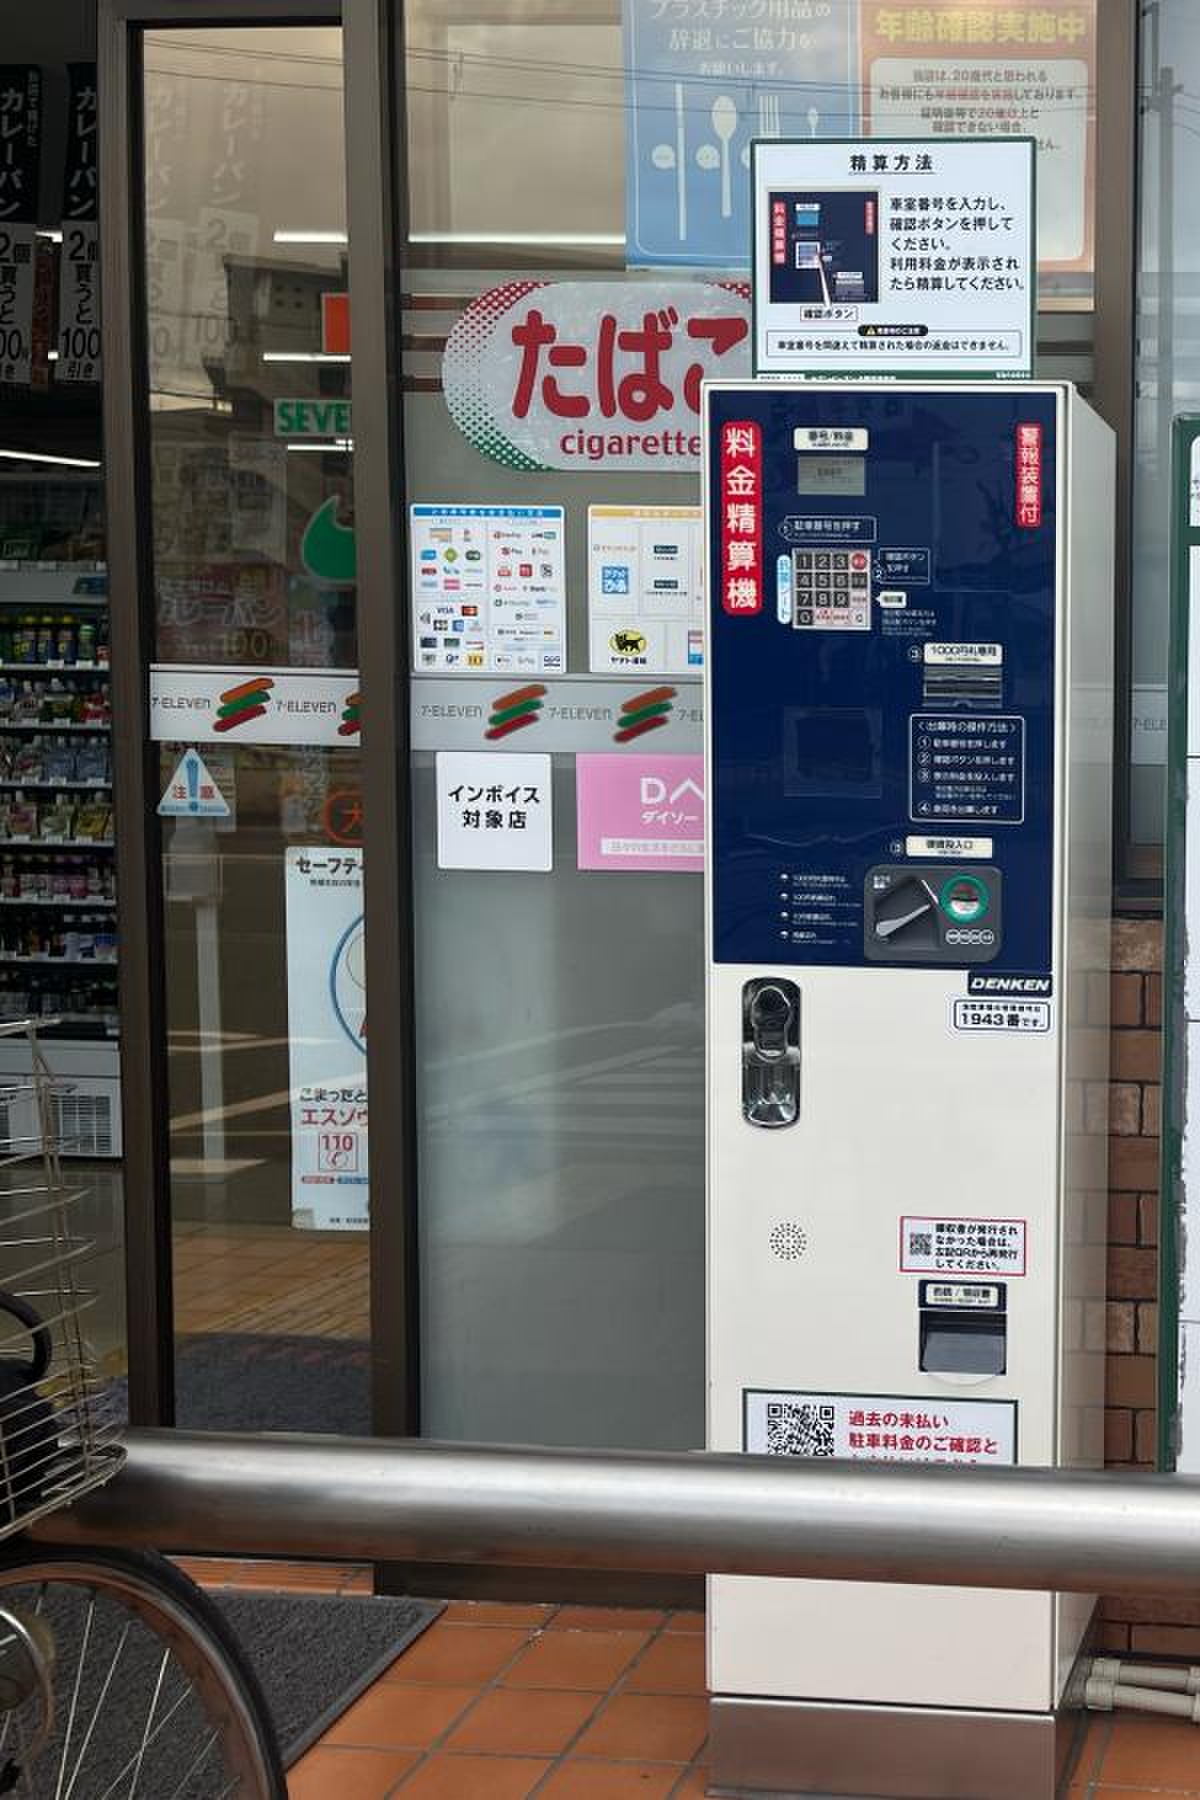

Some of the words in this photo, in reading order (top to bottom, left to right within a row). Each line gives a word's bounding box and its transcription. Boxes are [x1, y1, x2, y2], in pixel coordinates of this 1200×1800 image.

[849, 153, 935, 172] 精算方法
[889, 196, 1008, 212] 車室番号を入力し、
[889, 217, 1014, 233] 確認ボタンを押して
[891, 236, 951, 252] ください。
[889, 256, 1020, 272] 利用料金が表示され
[889, 276, 1025, 292] たら精算してください。
[726, 427, 757, 610] 料金精算機
[818, 556, 827, 568] 2
[836, 556, 845, 568] 3
[800, 575, 810, 586] 4
[819, 575, 828, 586] 5
[800, 593, 809, 605] 7
[819, 593, 828, 605] 8
[836, 593, 845, 605] 9
[448, 784, 541, 804] インボイス
[463, 810, 527, 829] 対象店
[970, 977, 1050, 991] DENKEN
[849, 1410, 949, 1428] 過去の未払い
[849, 1432, 998, 1454] 駐車料金のご確認と
